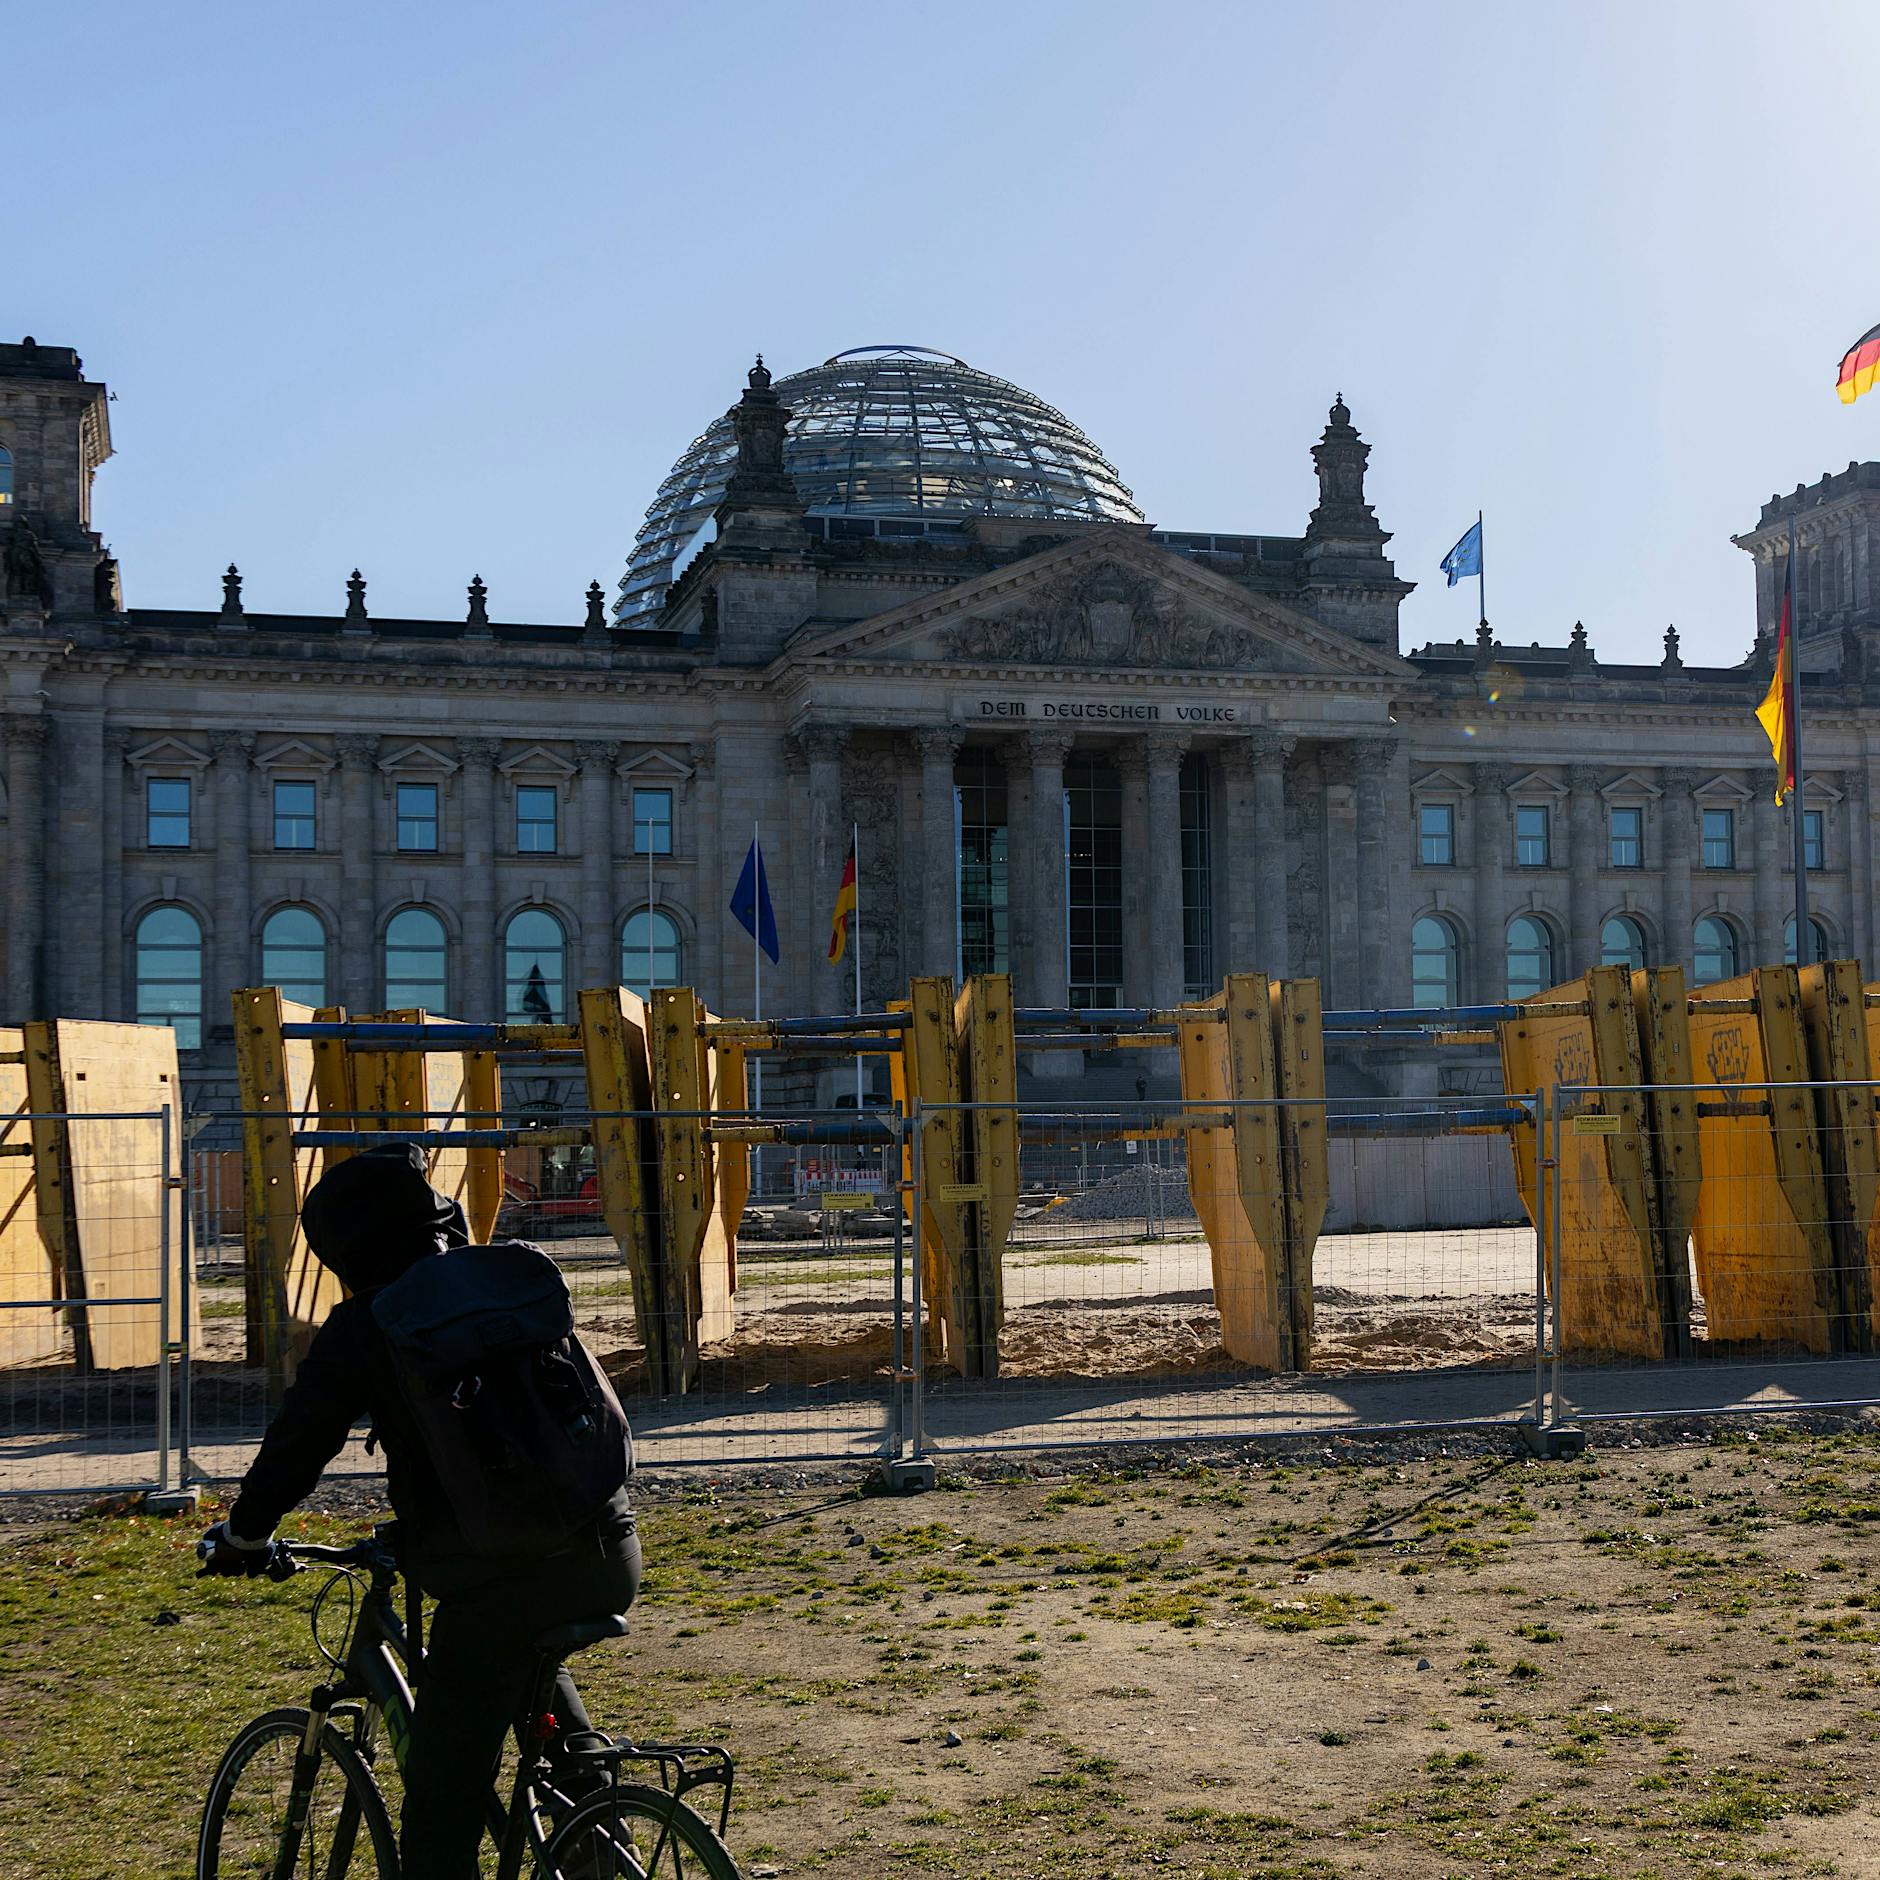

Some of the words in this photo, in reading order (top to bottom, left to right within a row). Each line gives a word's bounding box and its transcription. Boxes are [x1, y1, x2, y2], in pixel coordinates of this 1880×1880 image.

[980, 702, 1026, 716] DEM
[1043, 702, 1159, 720] DEUTSCHEN
[1176, 706, 1234, 722] VOLKE
